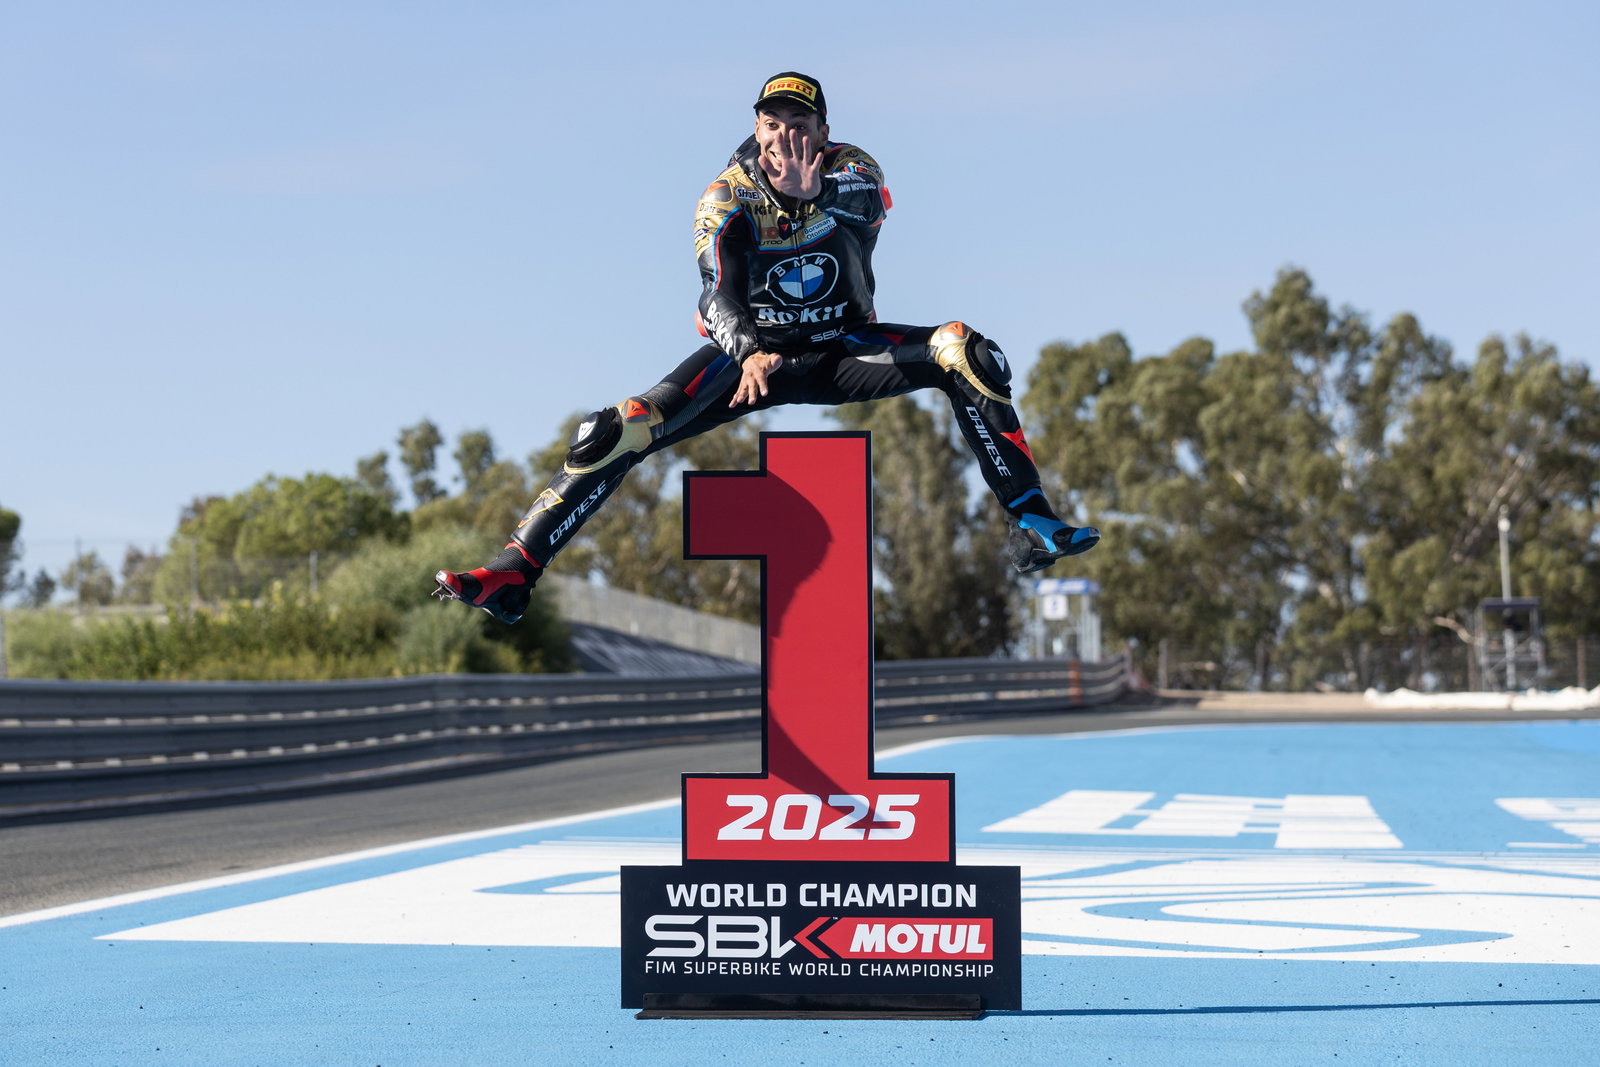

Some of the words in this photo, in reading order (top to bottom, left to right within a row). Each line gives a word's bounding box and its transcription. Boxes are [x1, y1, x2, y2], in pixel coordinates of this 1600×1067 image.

[804, 219, 831, 235] Borusan
[806, 224, 836, 240] Otomotiv
[774, 256, 827, 277] BMW
[811, 326, 847, 342] SBK
[966, 406, 1011, 477] DAINESE
[549, 480, 607, 546] DAINESE
[717, 794, 920, 841] 2025
[666, 883, 787, 907] WORLD
[799, 883, 977, 908] CHAMPION
[645, 914, 831, 959] SBK
[849, 923, 986, 954] MOTUL
[645, 961, 676, 974] FIM
[684, 962, 781, 976] SUPERBIKE
[789, 963, 851, 976] WORLD
[859, 963, 994, 978] CHAMPIONSHIP
